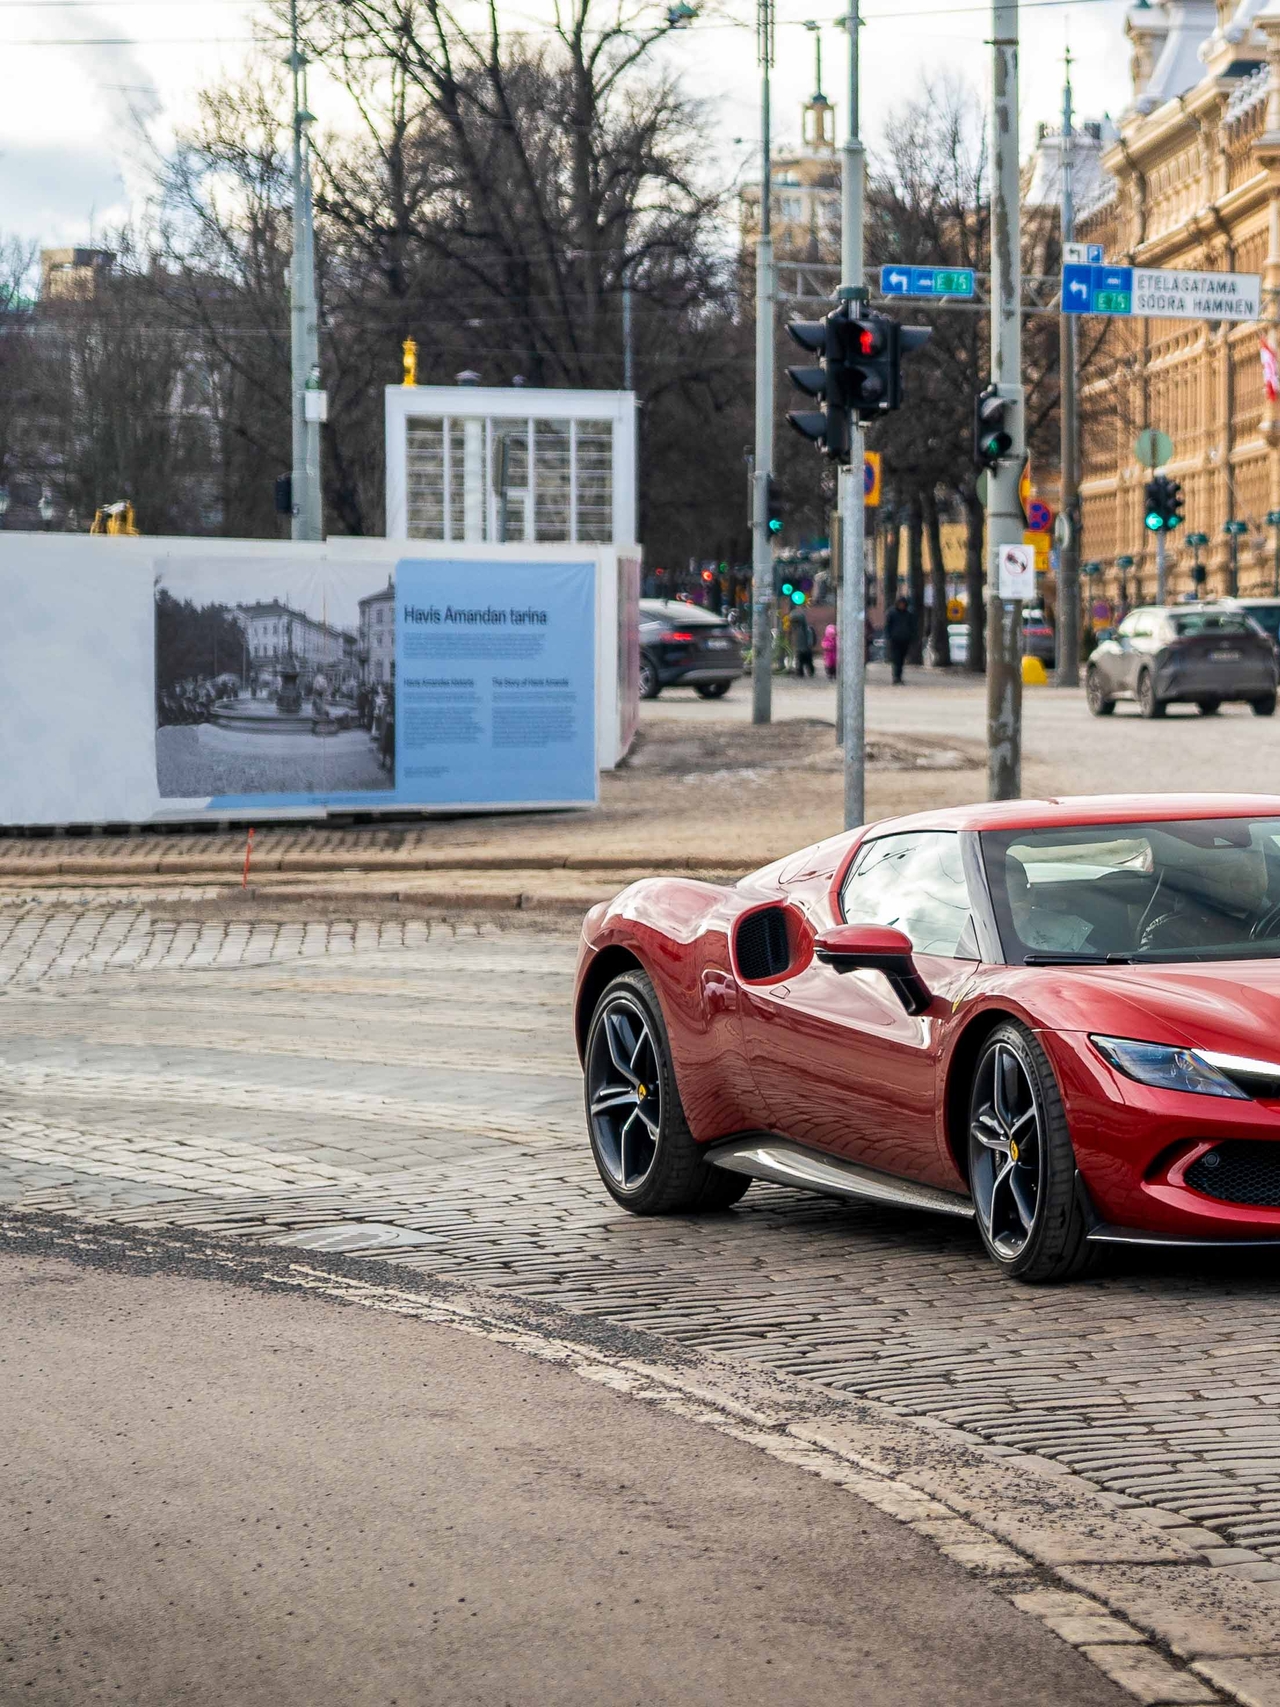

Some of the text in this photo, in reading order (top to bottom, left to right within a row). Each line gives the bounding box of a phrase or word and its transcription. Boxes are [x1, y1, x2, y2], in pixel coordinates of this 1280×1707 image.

[1193, 297, 1254, 316] HAMNEN
[404, 604, 548, 625] Havis Amandan tarina
